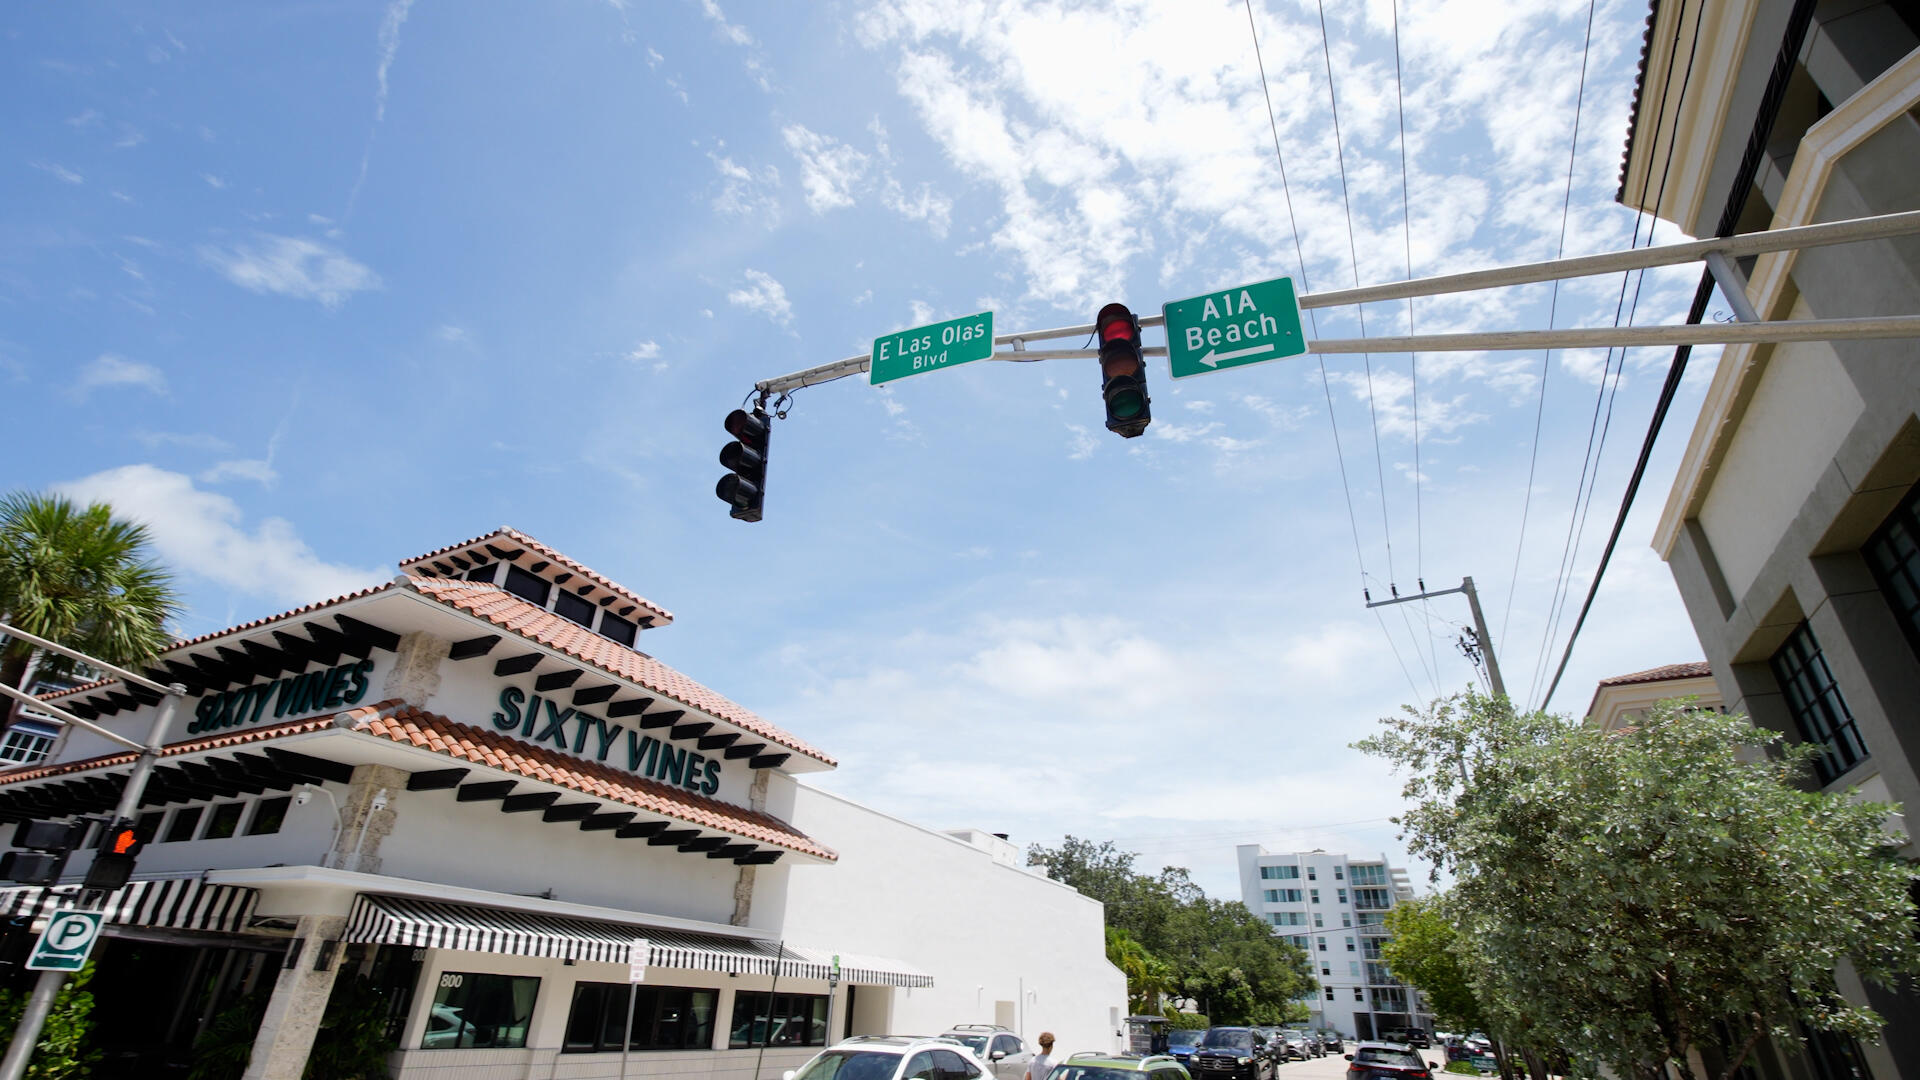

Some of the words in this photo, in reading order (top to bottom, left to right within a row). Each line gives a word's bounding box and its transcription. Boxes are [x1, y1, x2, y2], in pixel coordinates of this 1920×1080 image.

[1202, 290, 1257, 322] A1A
[880, 341, 891, 361] E
[898, 335, 931, 356] Las
[942, 323, 985, 345] Olas
[1185, 313, 1278, 351] Beach
[913, 350, 948, 369] Blvd
[187, 680, 280, 735] SIXTY
[273, 658, 375, 719] VINES
[492, 686, 624, 761] SIXTY
[628, 730, 721, 795] VINES
[56, 920, 87, 945] P
[440, 973, 464, 988] 800
